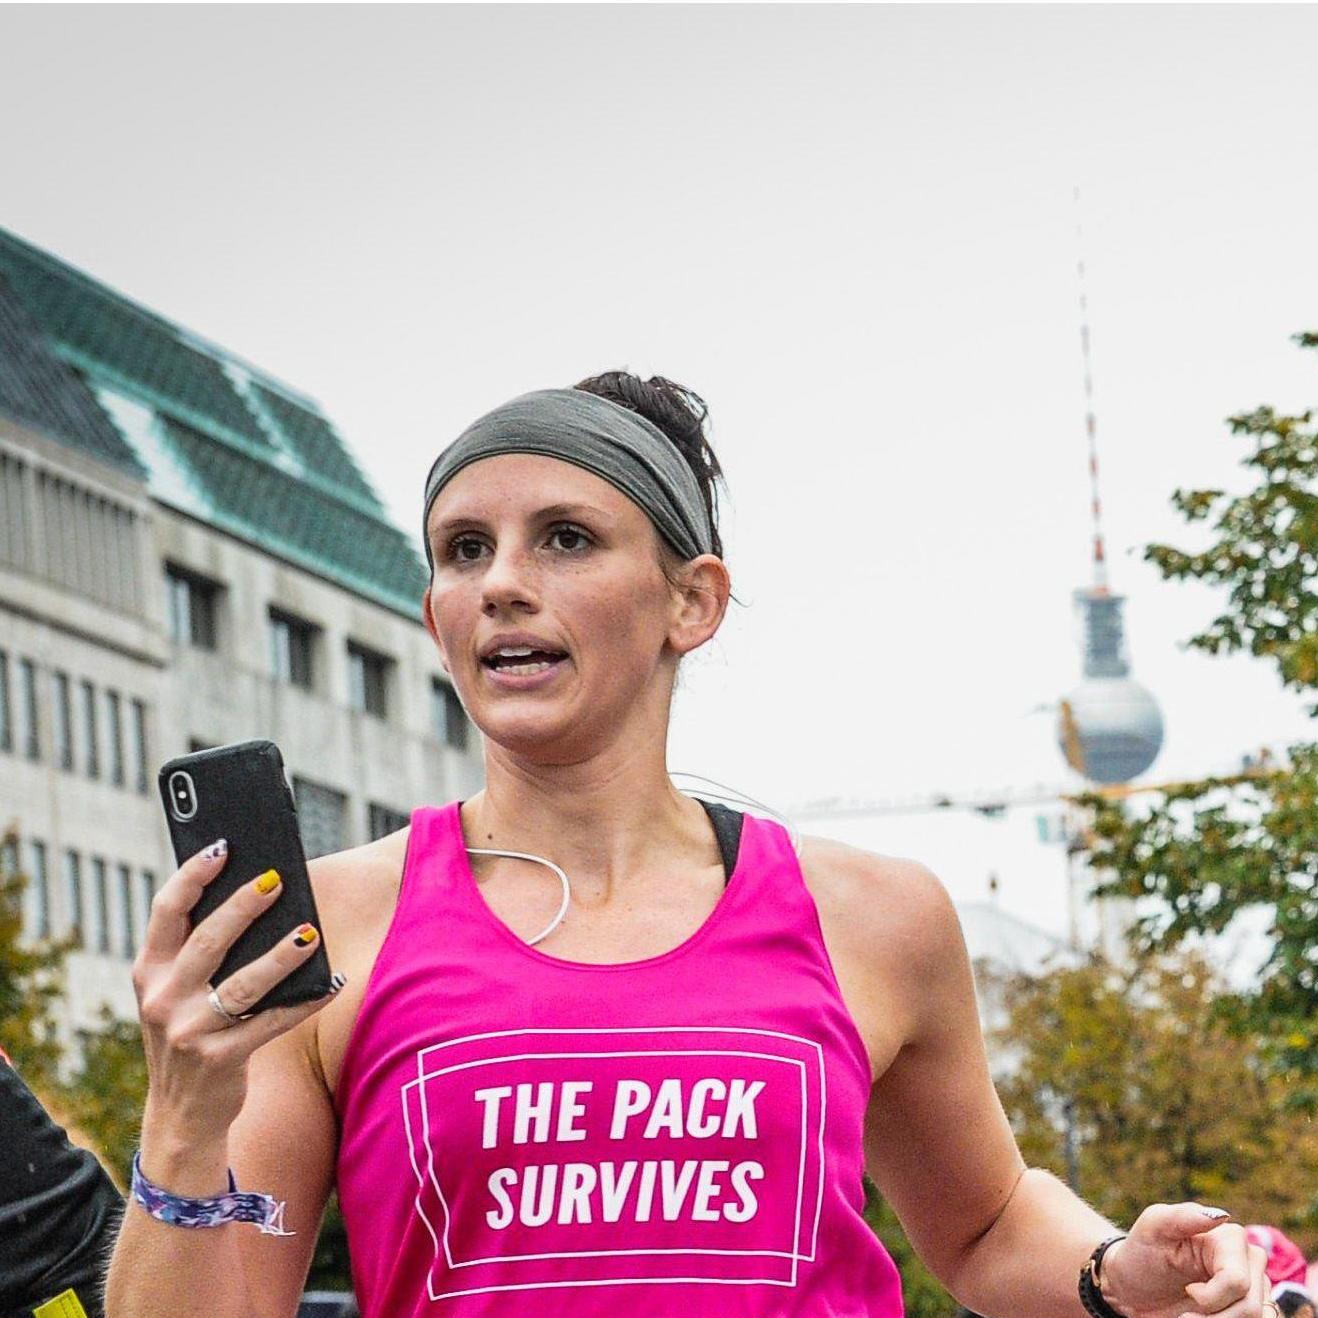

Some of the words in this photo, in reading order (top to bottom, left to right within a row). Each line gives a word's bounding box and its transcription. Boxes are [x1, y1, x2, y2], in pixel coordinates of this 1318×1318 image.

[474, 1081, 594, 1150] THE
[609, 1078, 767, 1140] PACK
[485, 1160, 766, 1230] SURVIVES
